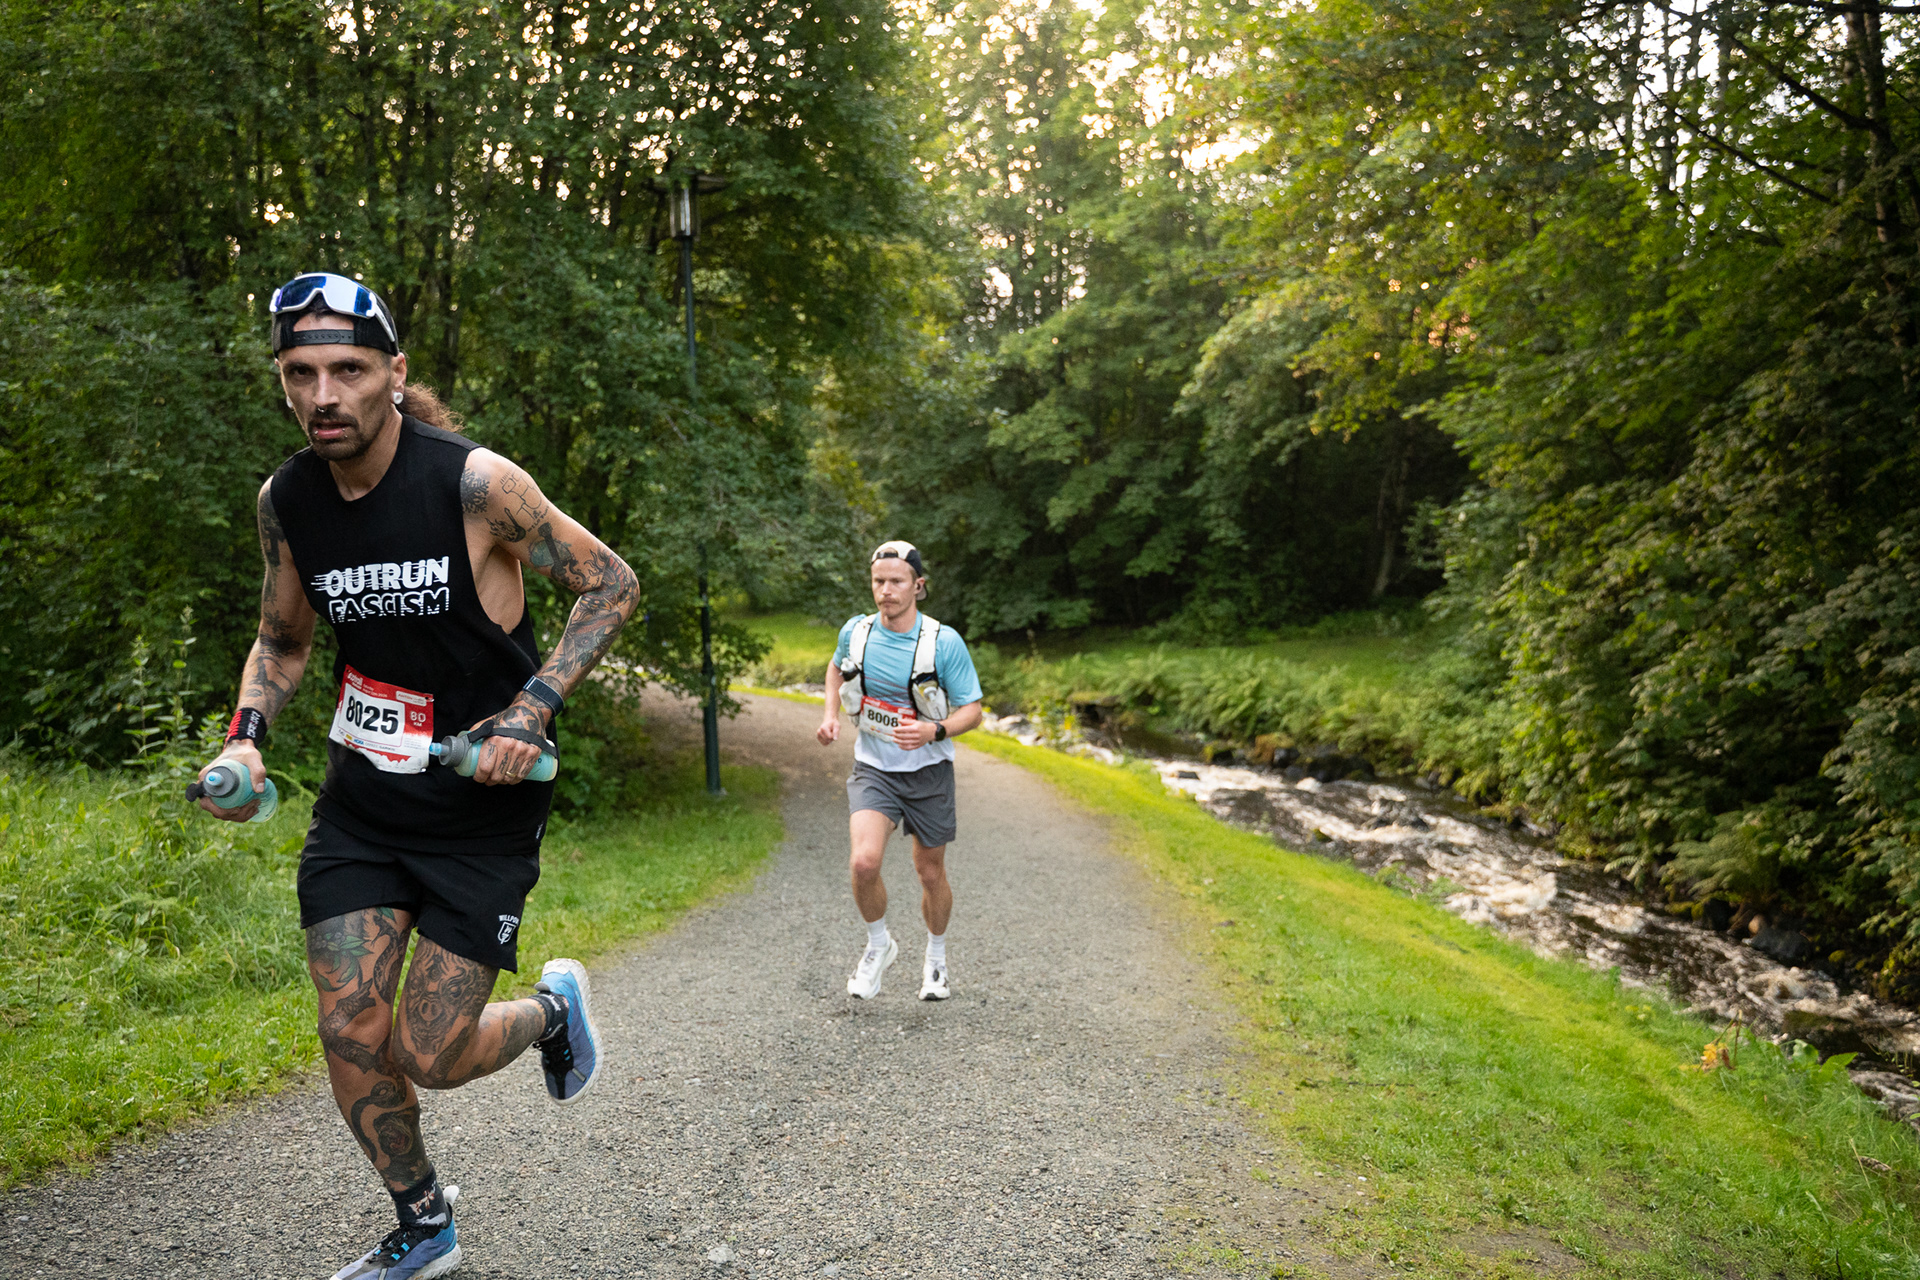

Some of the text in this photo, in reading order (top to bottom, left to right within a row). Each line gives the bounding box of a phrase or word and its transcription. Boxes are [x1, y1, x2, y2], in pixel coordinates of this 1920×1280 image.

[324, 556, 449, 597] OUTRUN
[329, 587, 450, 623] FASCISM
[346, 695, 399, 735] 8025
[410, 711, 426, 723] 80
[867, 709, 899, 727] 8008
